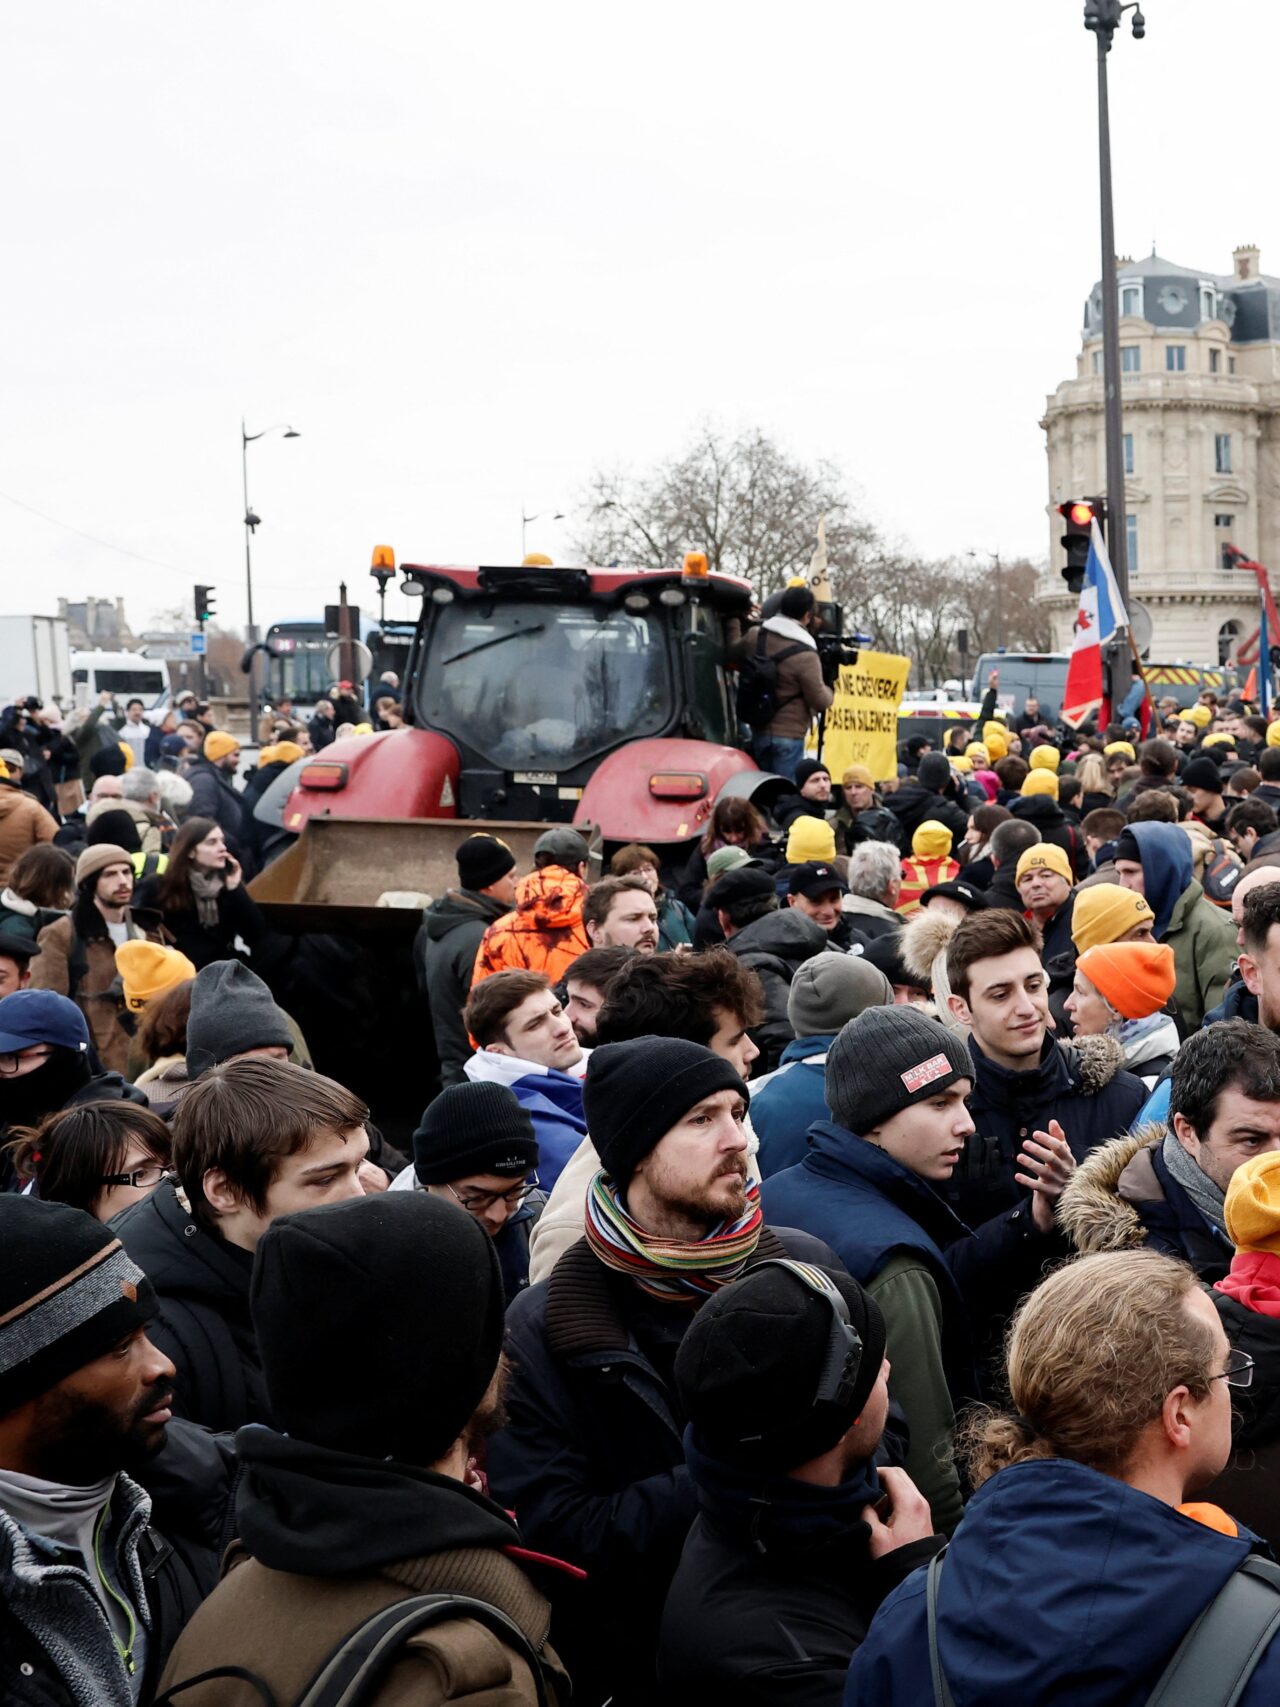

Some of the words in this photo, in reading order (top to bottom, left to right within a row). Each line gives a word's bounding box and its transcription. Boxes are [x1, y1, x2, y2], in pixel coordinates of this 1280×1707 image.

[827, 707, 843, 731] PAS
[844, 708, 857, 731] EN
[857, 709, 892, 733] SILENCE
